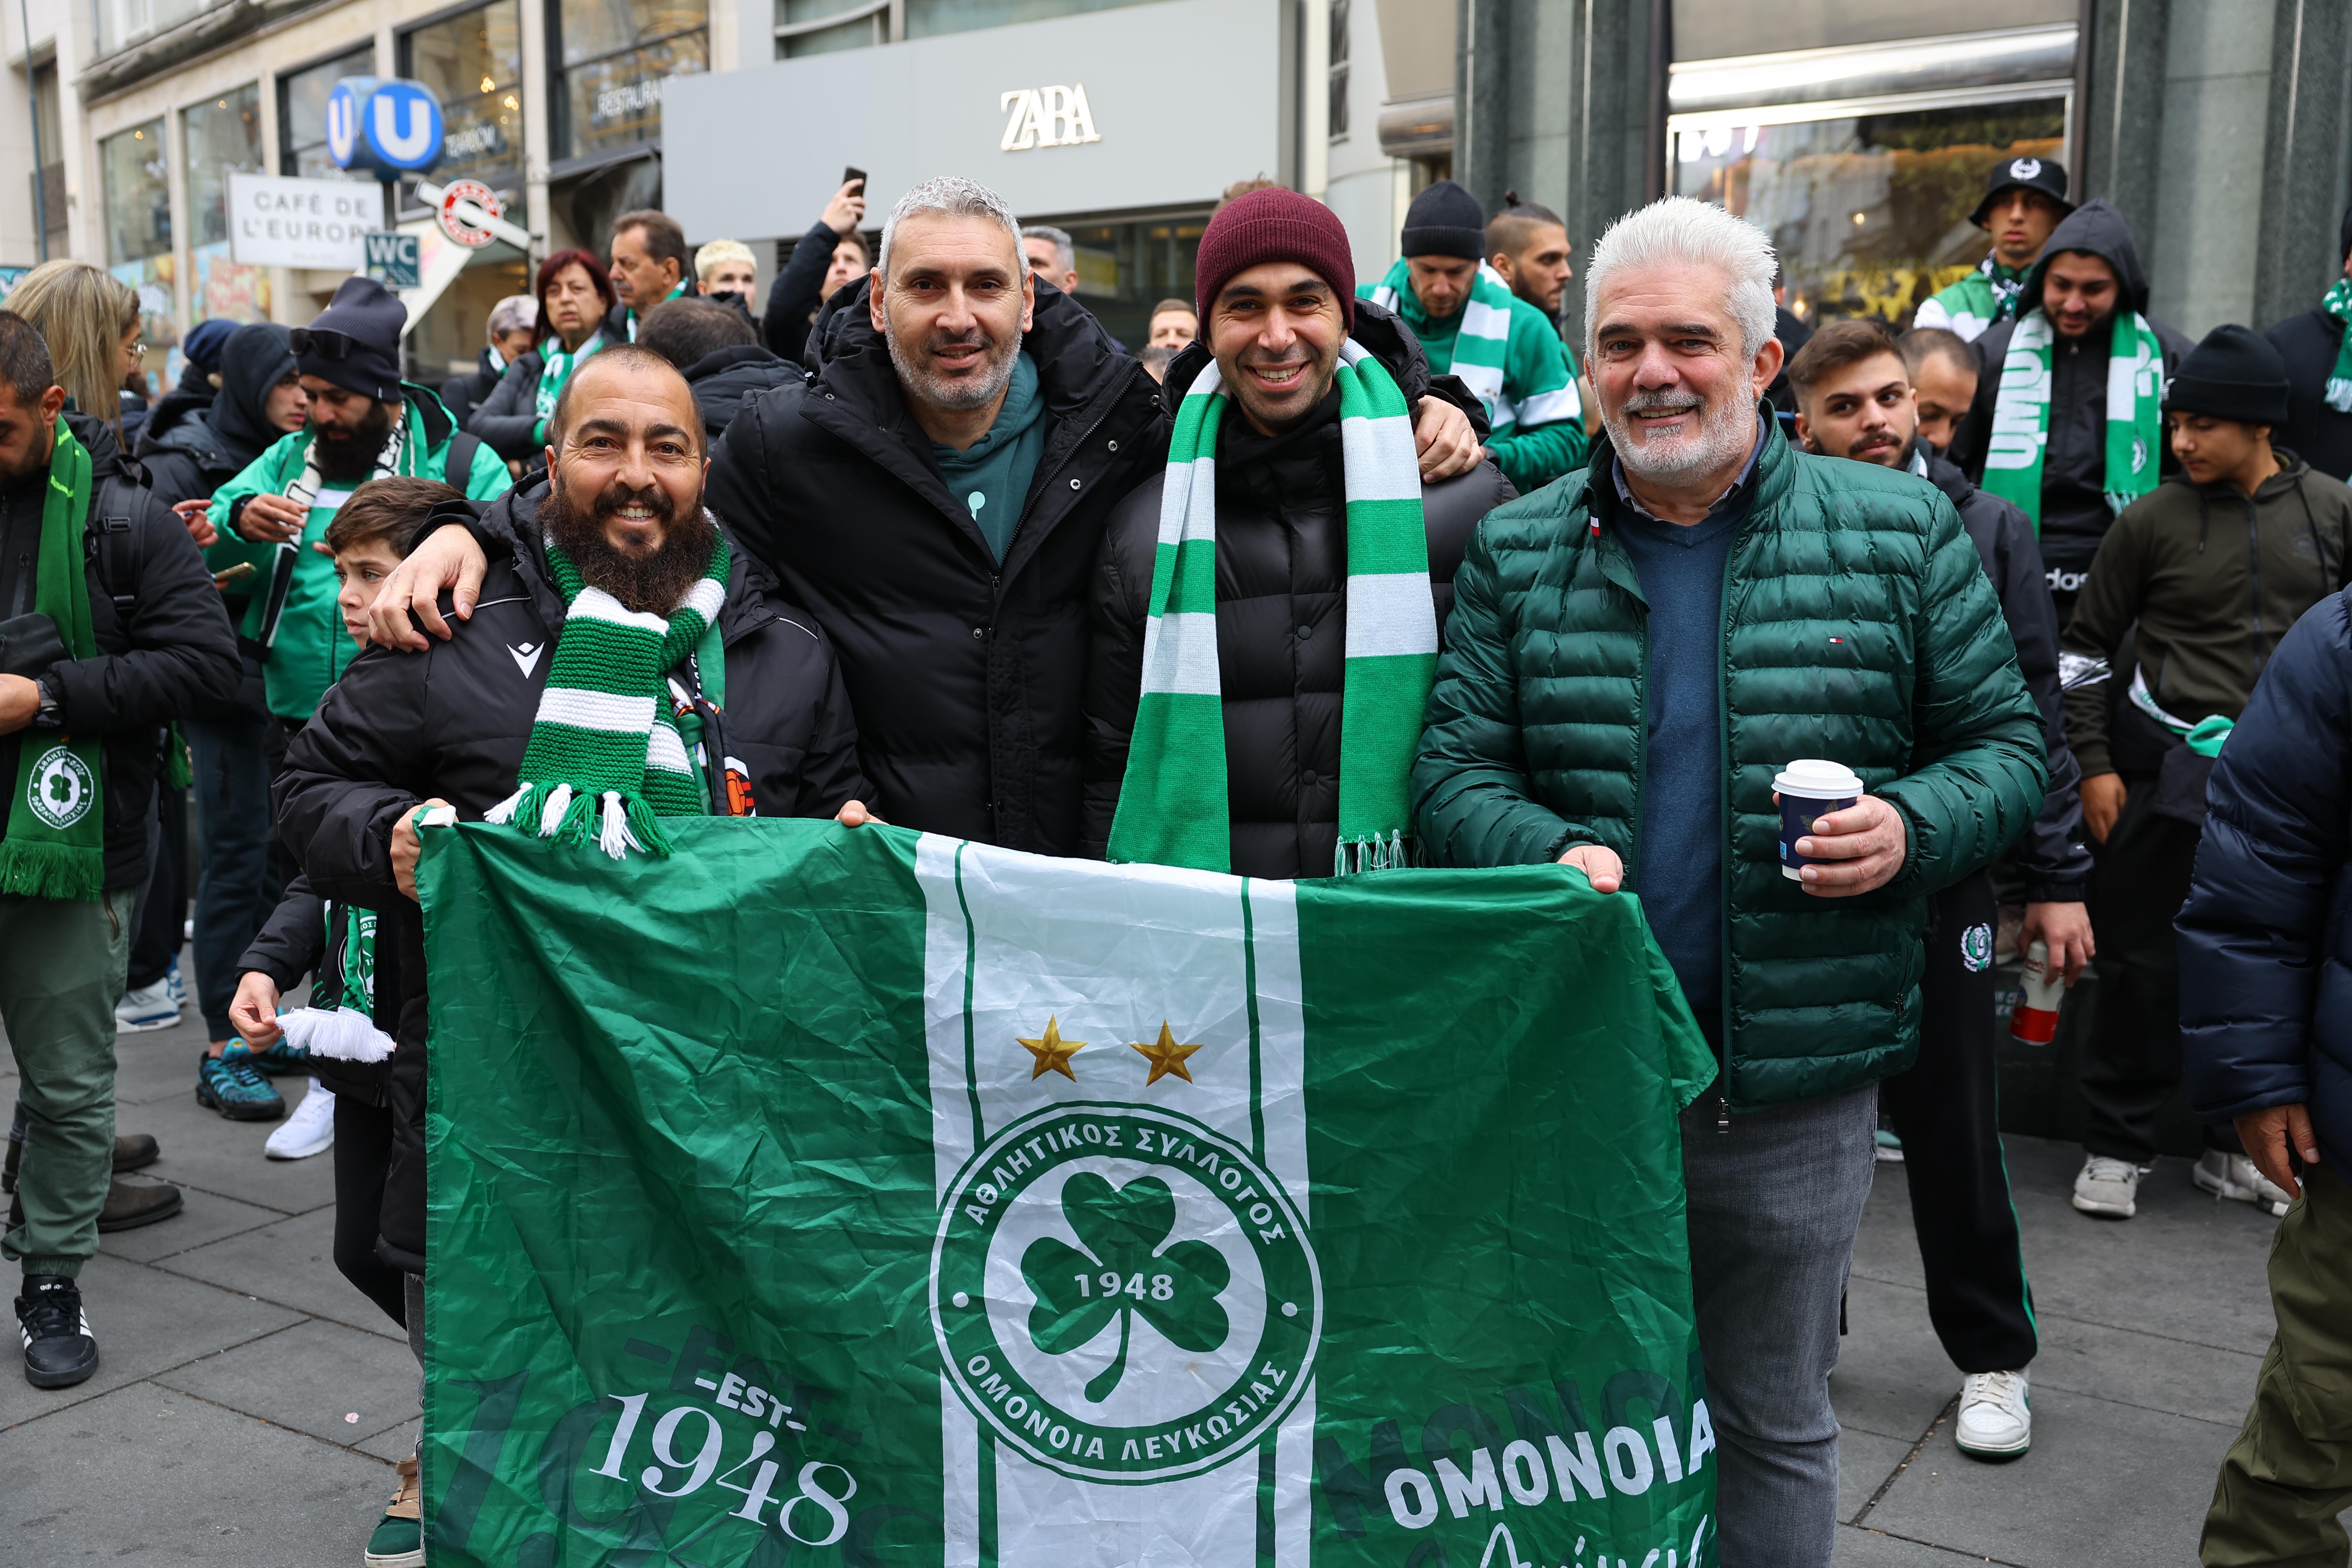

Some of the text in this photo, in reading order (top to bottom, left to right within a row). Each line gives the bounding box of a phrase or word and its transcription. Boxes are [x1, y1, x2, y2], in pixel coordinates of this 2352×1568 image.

[328, 95, 352, 162] U
[374, 94, 431, 162] U
[1000, 82, 1102, 151] ZARA
[254, 190, 368, 218] CAFÉ DE
[368, 237, 416, 266] WC
[964, 1123, 1286, 1245] ΑΘΛΗΤΙΚΟΣ ΣΥΛΛΟΓΟΣ
[1074, 1272, 1174, 1301] 1948
[1121, 1360, 1287, 1461] ΛΕΥΚΩΣΙΑΣ
[588, 1392, 857, 1546] 1948
